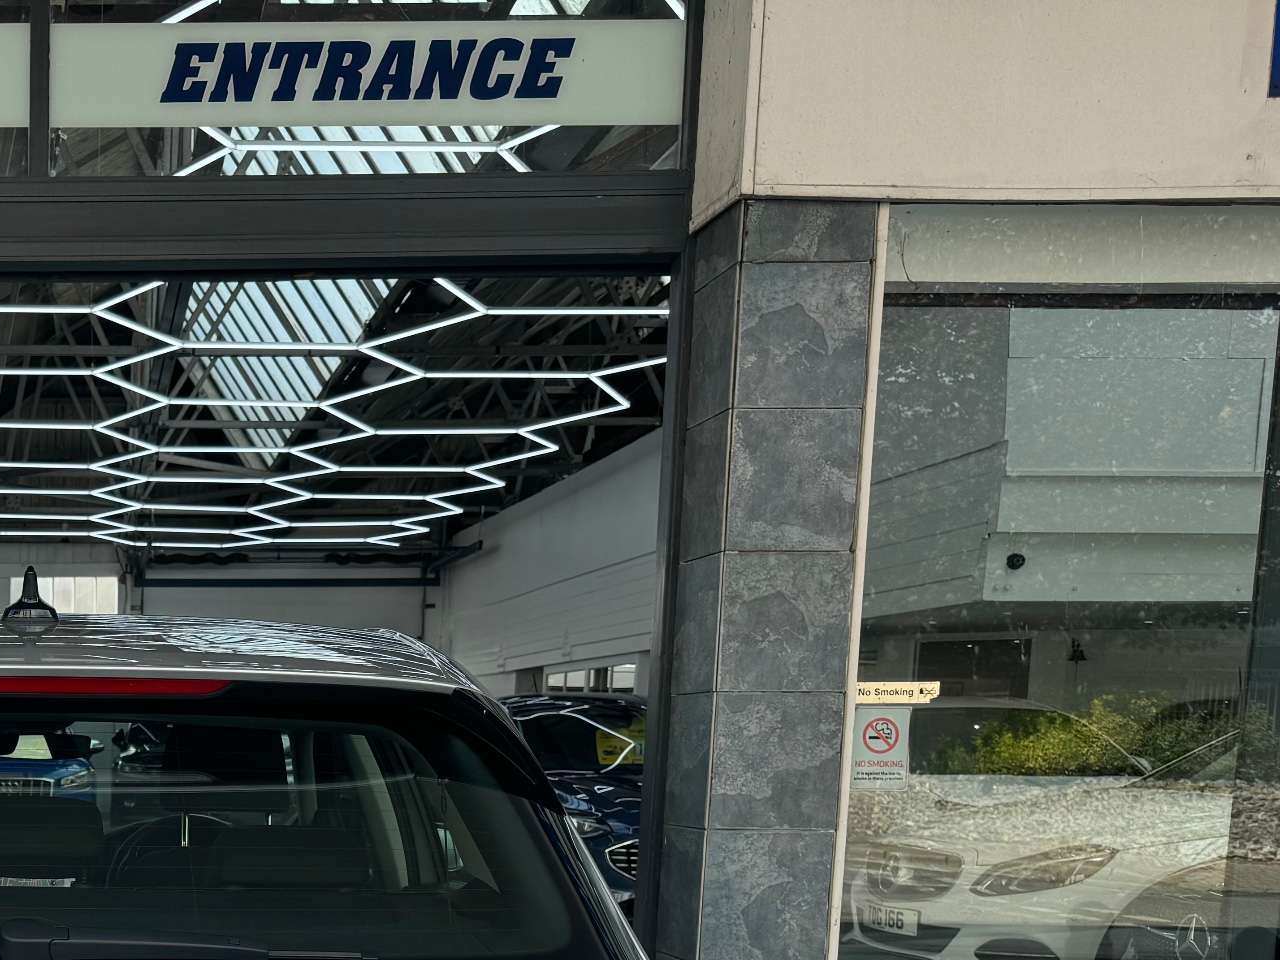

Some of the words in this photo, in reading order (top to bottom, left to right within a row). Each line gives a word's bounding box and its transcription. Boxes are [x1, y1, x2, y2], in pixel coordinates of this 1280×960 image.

[159, 37, 577, 103] ENTRANCE
[858, 688, 871, 697] No
[874, 687, 914, 698] Smoking
[854, 760, 866, 768] NO
